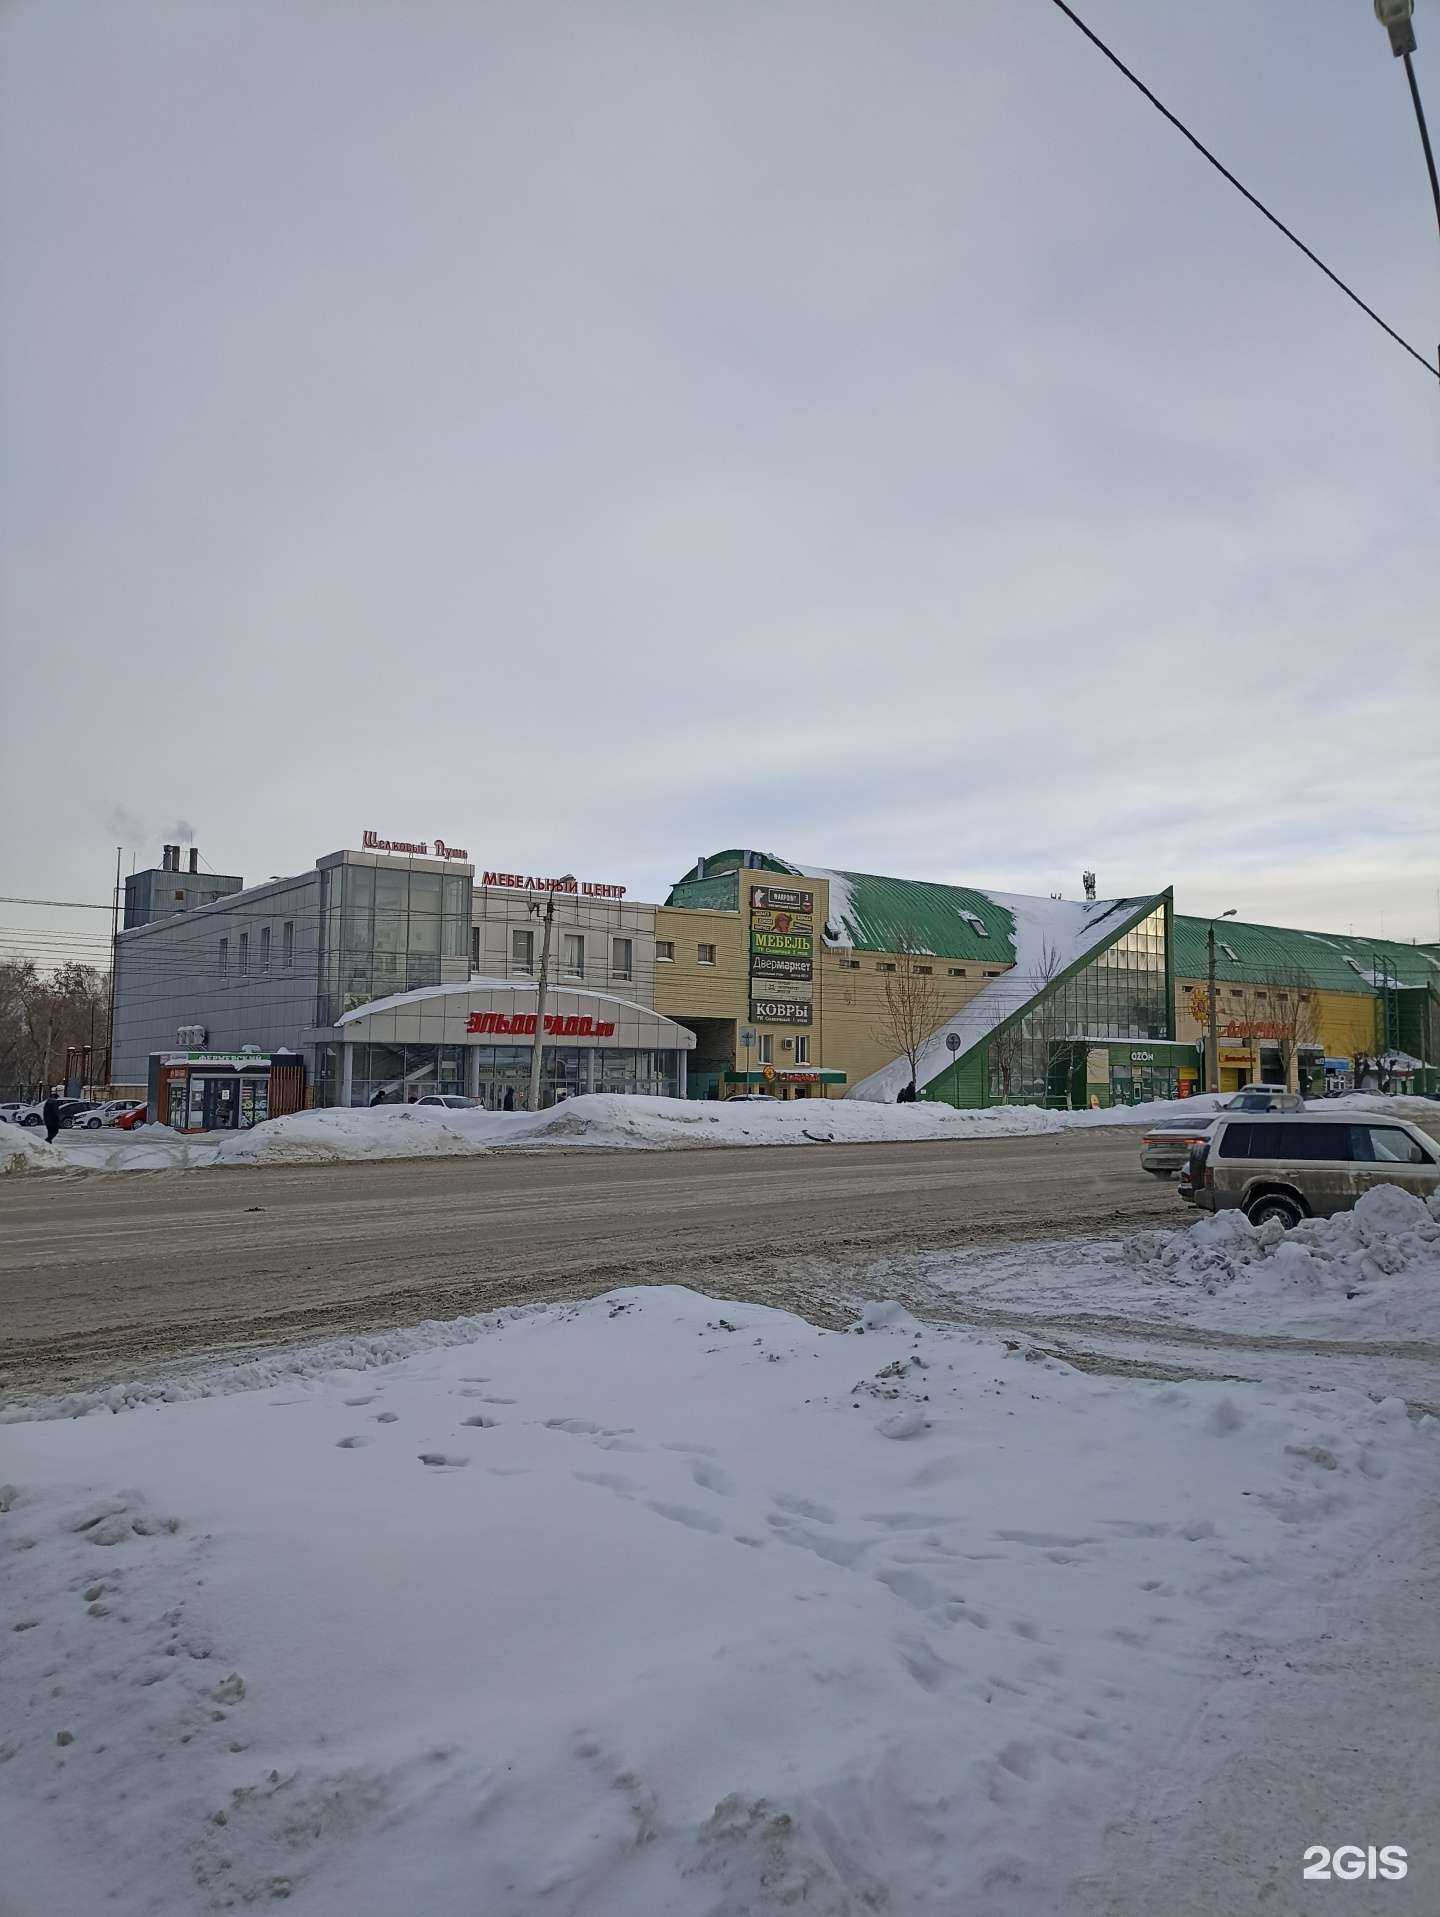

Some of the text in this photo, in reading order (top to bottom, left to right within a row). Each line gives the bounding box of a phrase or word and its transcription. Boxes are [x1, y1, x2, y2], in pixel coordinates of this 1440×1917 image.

[484, 871, 626, 898] МЕБЕЛЬНЫЙ ЦЕНТР
[755, 933, 810, 950] МЕБЕЛЬ
[753, 956, 811, 972] Двермаркет
[756, 1002, 808, 1017] КОВРЫ
[1131, 1051, 1153, 1061] OZON
